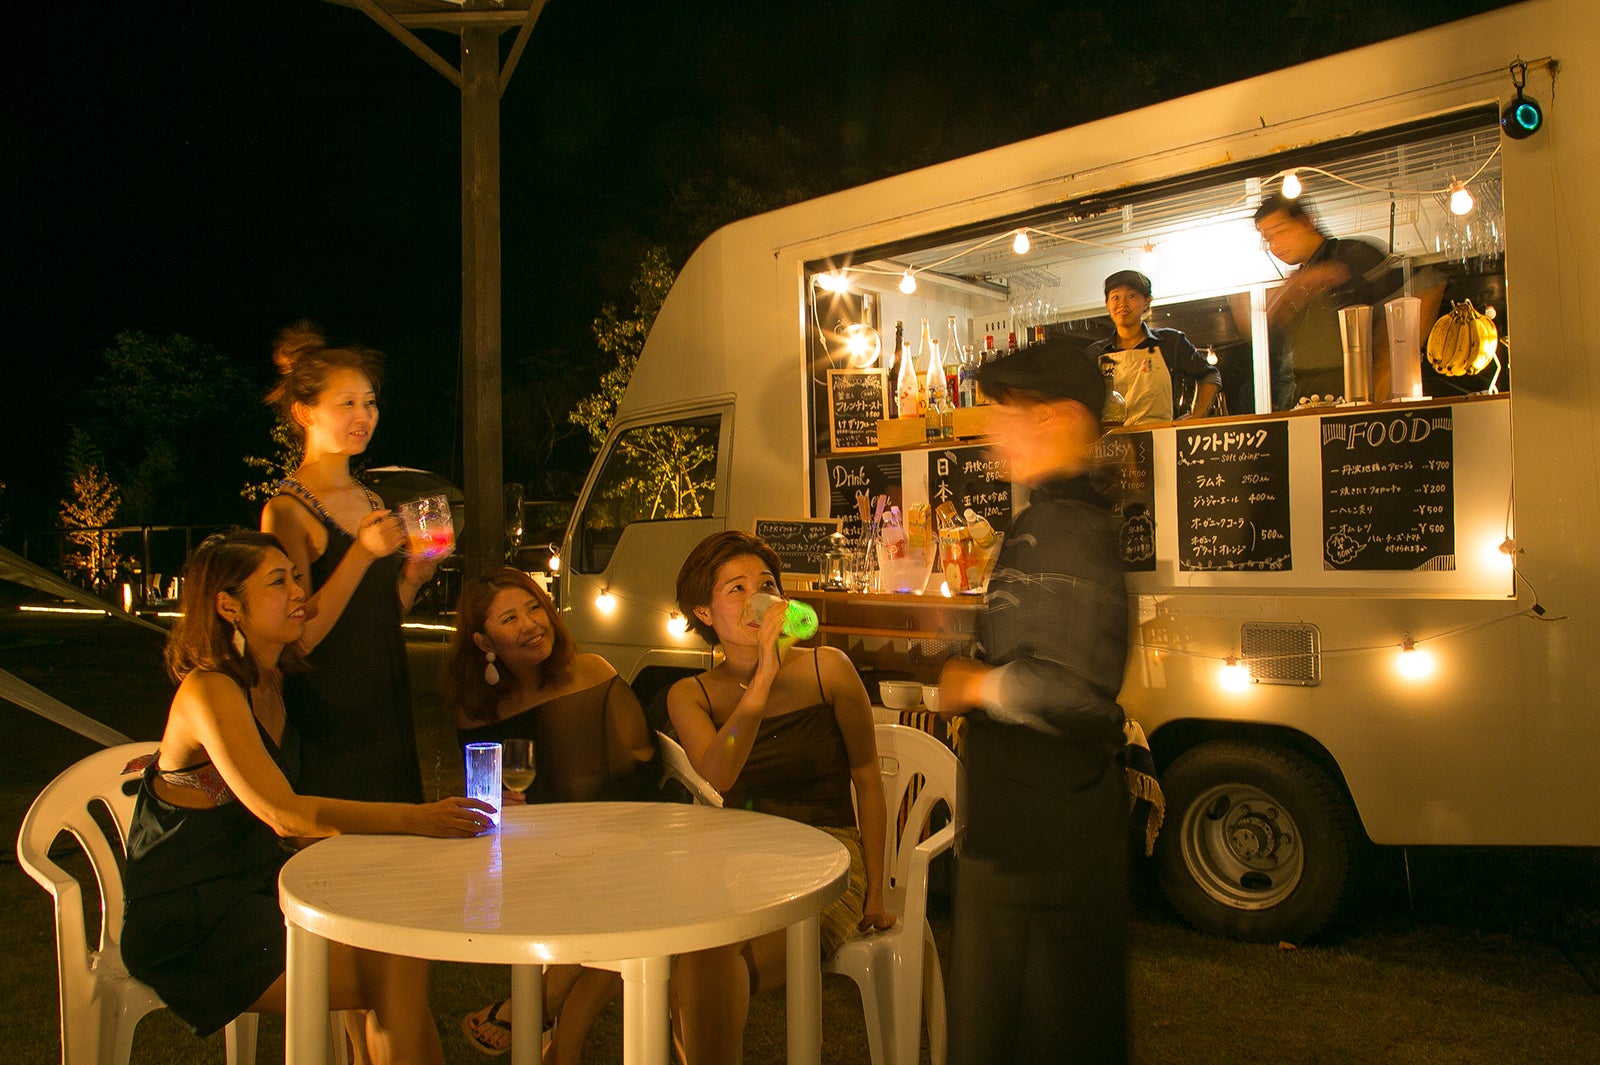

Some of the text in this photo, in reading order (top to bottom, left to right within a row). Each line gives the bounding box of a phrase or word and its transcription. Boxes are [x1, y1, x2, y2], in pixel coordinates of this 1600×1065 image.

[835, 400, 883, 412] フレンチトースト
[837, 418, 878, 430] けずりフルー
[1345, 417, 1431, 450] FOOD
[1187, 429, 1268, 456] ソフトドリンク
[1428, 459, 1450, 471] ¥700
[832, 465, 870, 488] Drink
[1196, 473, 1226, 489] ラムネ
[1422, 483, 1446, 494] ¥200
[1193, 494, 1240, 508] ジンジャーエール
[1418, 504, 1444, 515] ¥500
[1190, 517, 1245, 530] オーガニックコーラ
[1339, 522, 1445, 535] オムレツ ¥500
[1190, 535, 1218, 546] オーガニック
